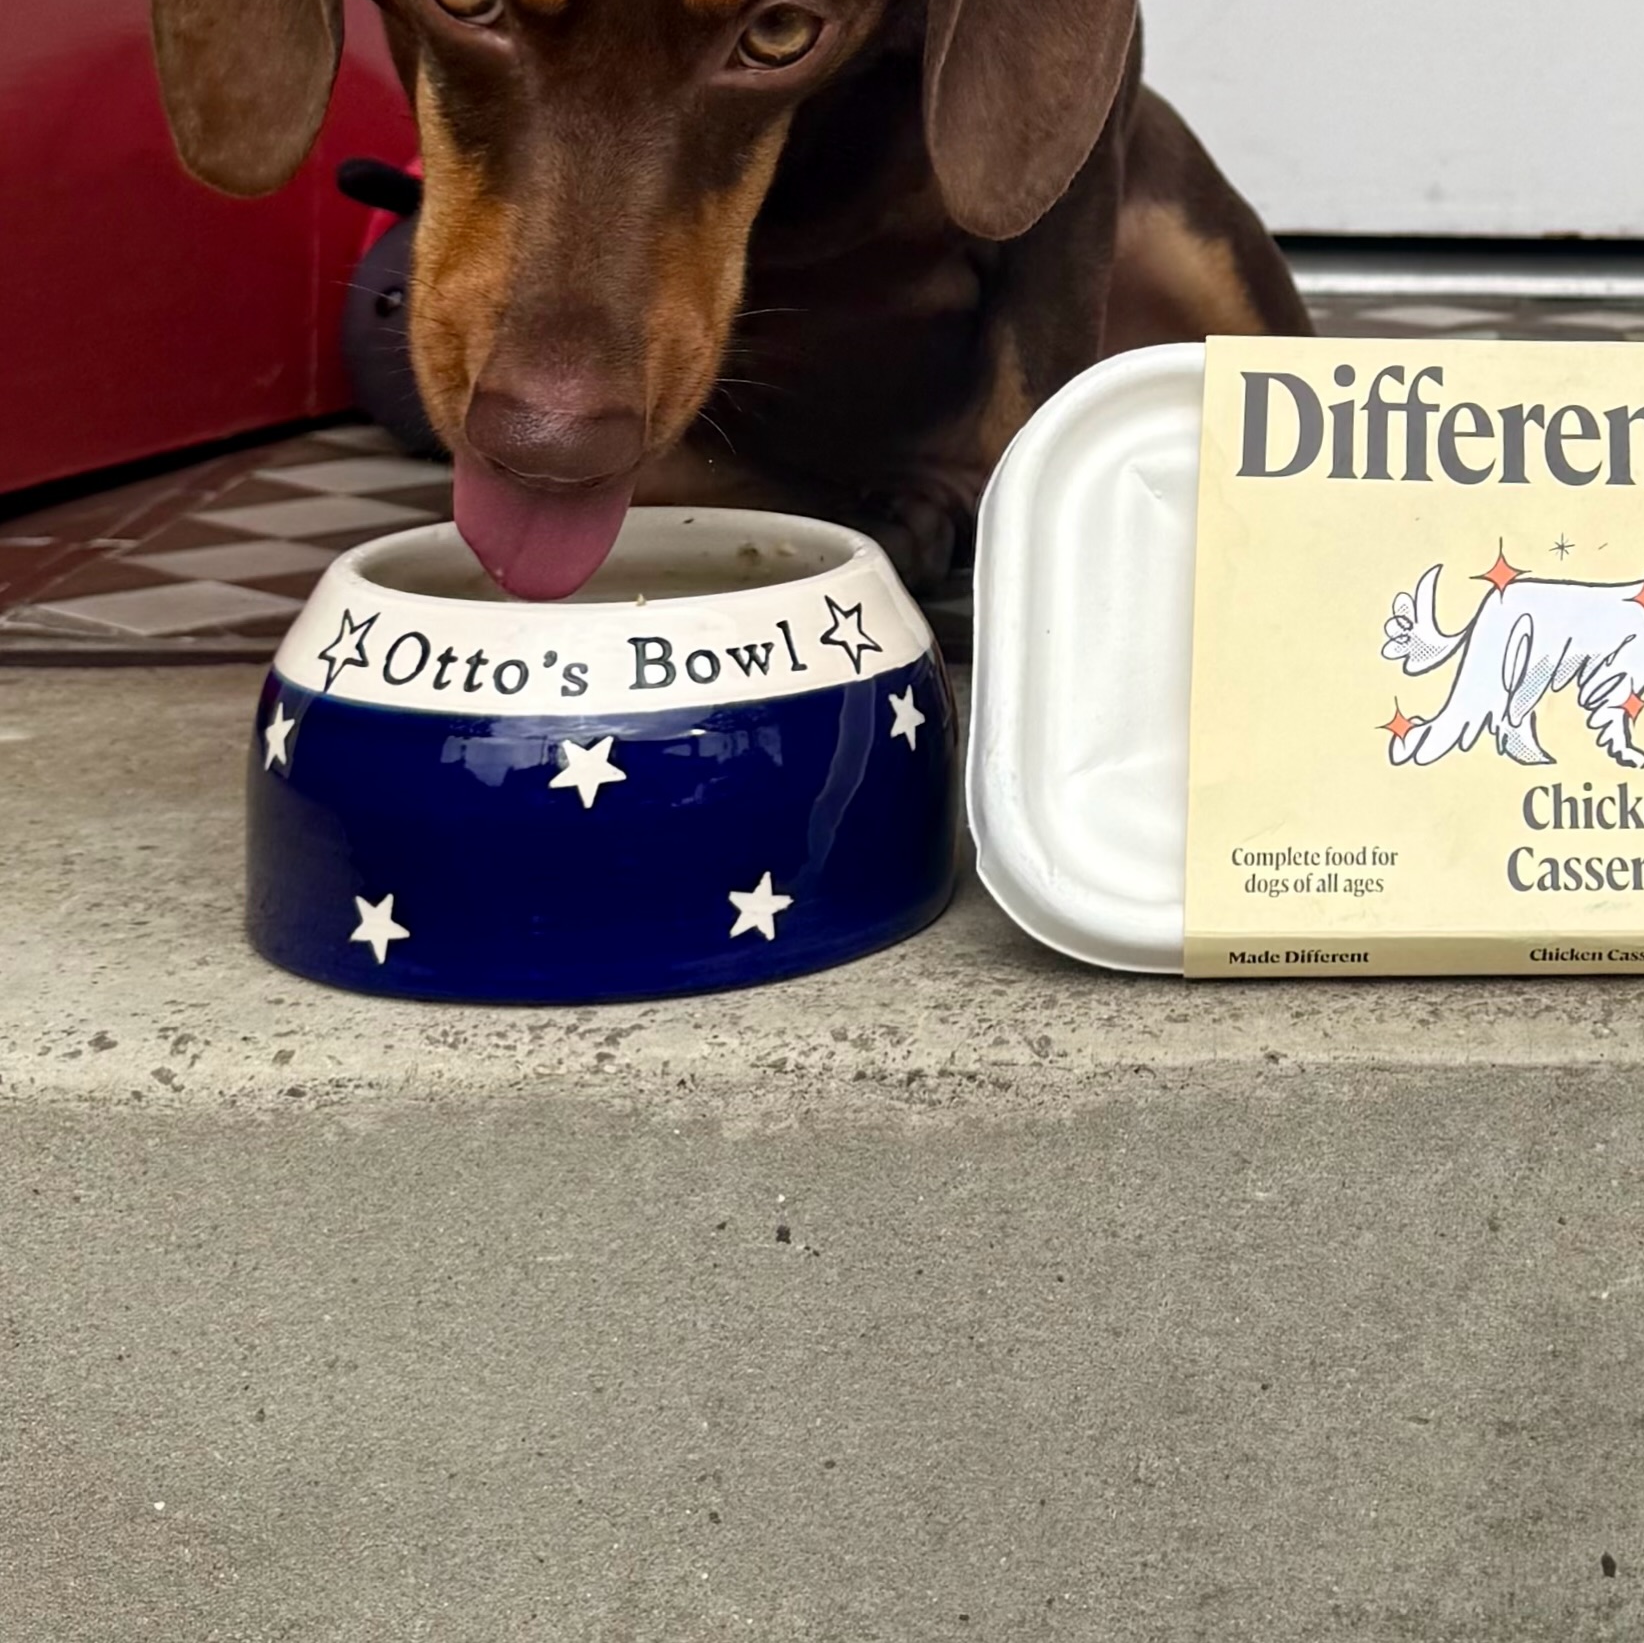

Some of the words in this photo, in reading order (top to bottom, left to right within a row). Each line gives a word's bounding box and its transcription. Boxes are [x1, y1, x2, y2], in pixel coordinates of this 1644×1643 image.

[383, 630, 590, 698] Otto's
[628, 621, 808, 690] Bowl
[1231, 846, 1321, 870] Complete
[1325, 846, 1367, 866] food
[1372, 846, 1399, 866] for
[1244, 873, 1290, 897] dogs
[1293, 873, 1314, 894] of
[1316, 873, 1338, 893] all
[1343, 878, 1384, 897] ages
[1229, 950, 1281, 964] Made
[1285, 949, 1370, 964] Different
[1529, 947, 1603, 962] Chicken
